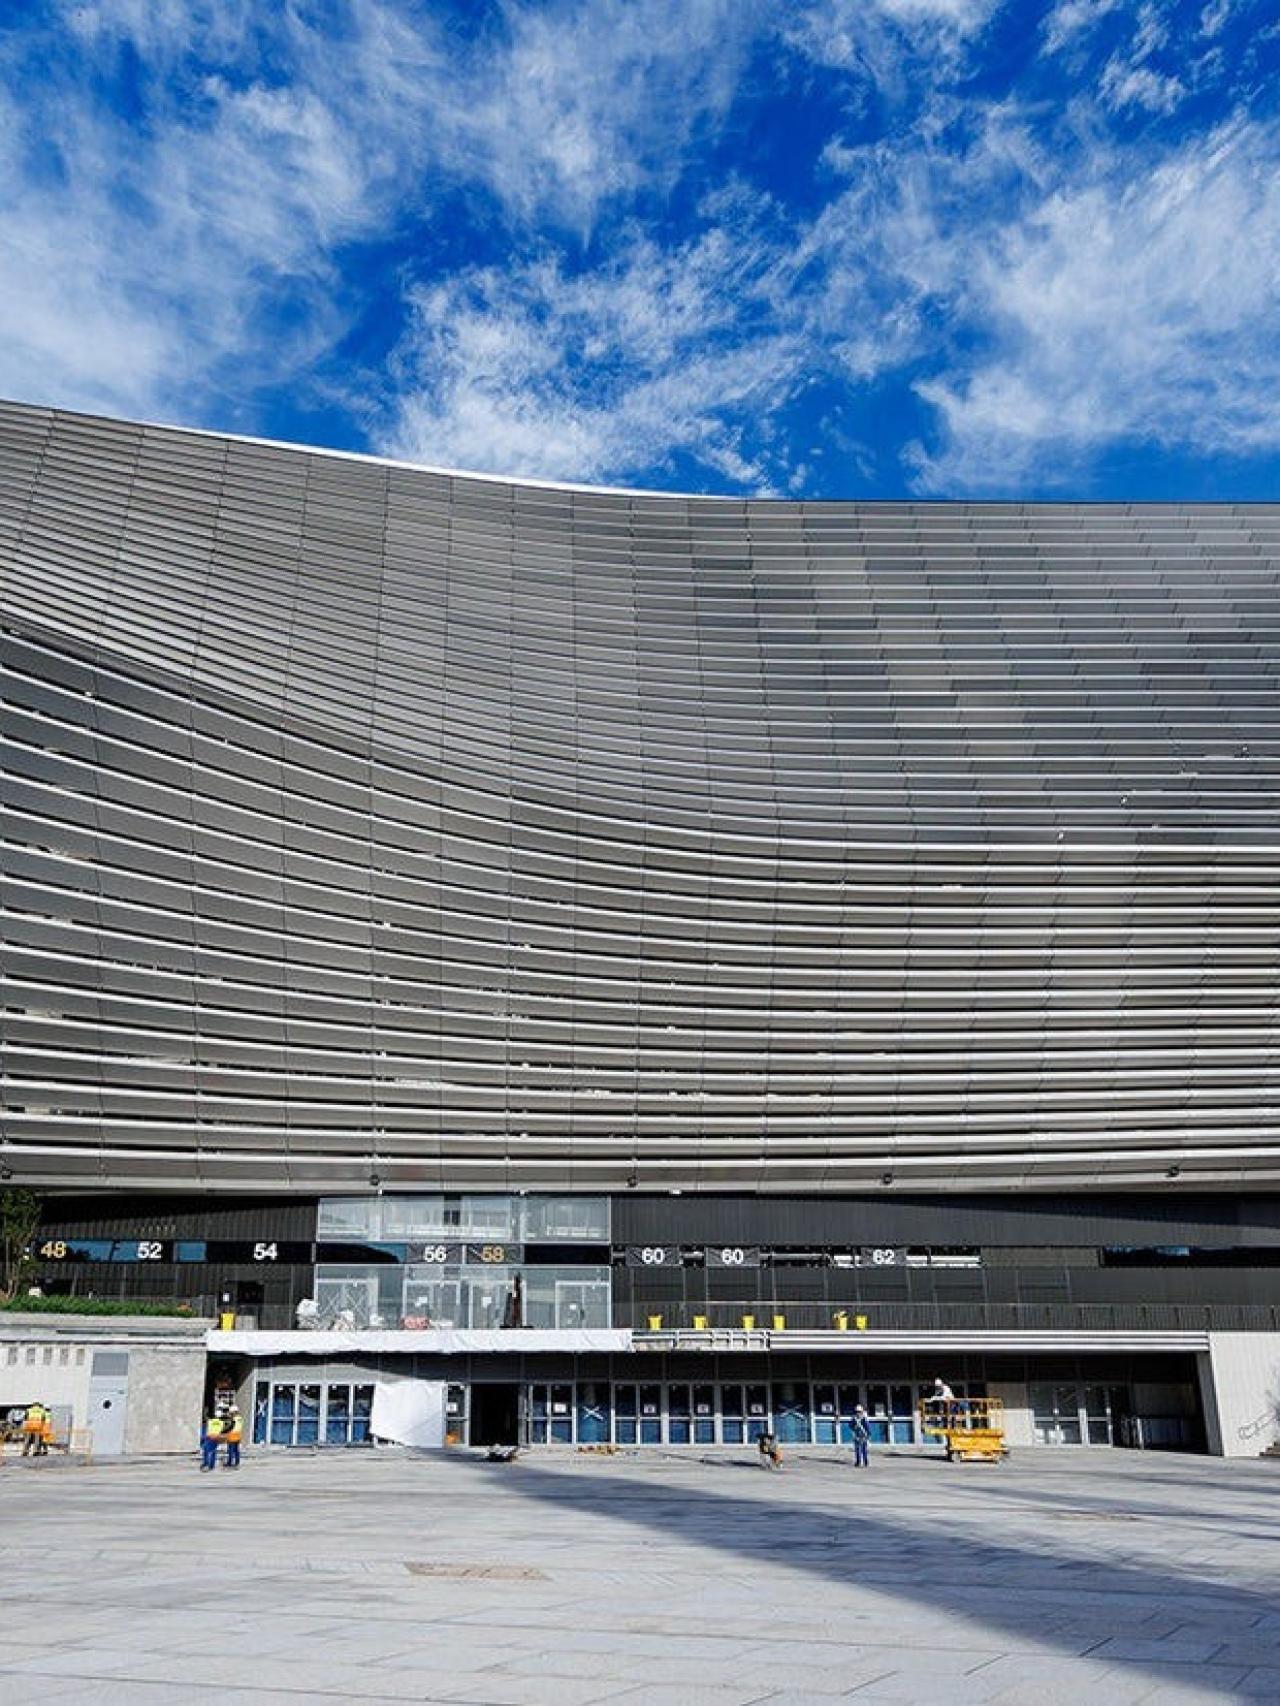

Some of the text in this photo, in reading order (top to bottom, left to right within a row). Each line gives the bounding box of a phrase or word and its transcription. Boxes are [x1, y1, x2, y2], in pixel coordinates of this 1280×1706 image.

[40, 1241, 67, 1259] 48
[137, 1241, 162, 1259] 52
[254, 1242, 278, 1260] 54
[425, 1245, 446, 1262] 56
[482, 1245, 504, 1262] 58
[642, 1247, 664, 1264] 60
[722, 1248, 743, 1264] 60
[873, 1249, 895, 1264] 62
